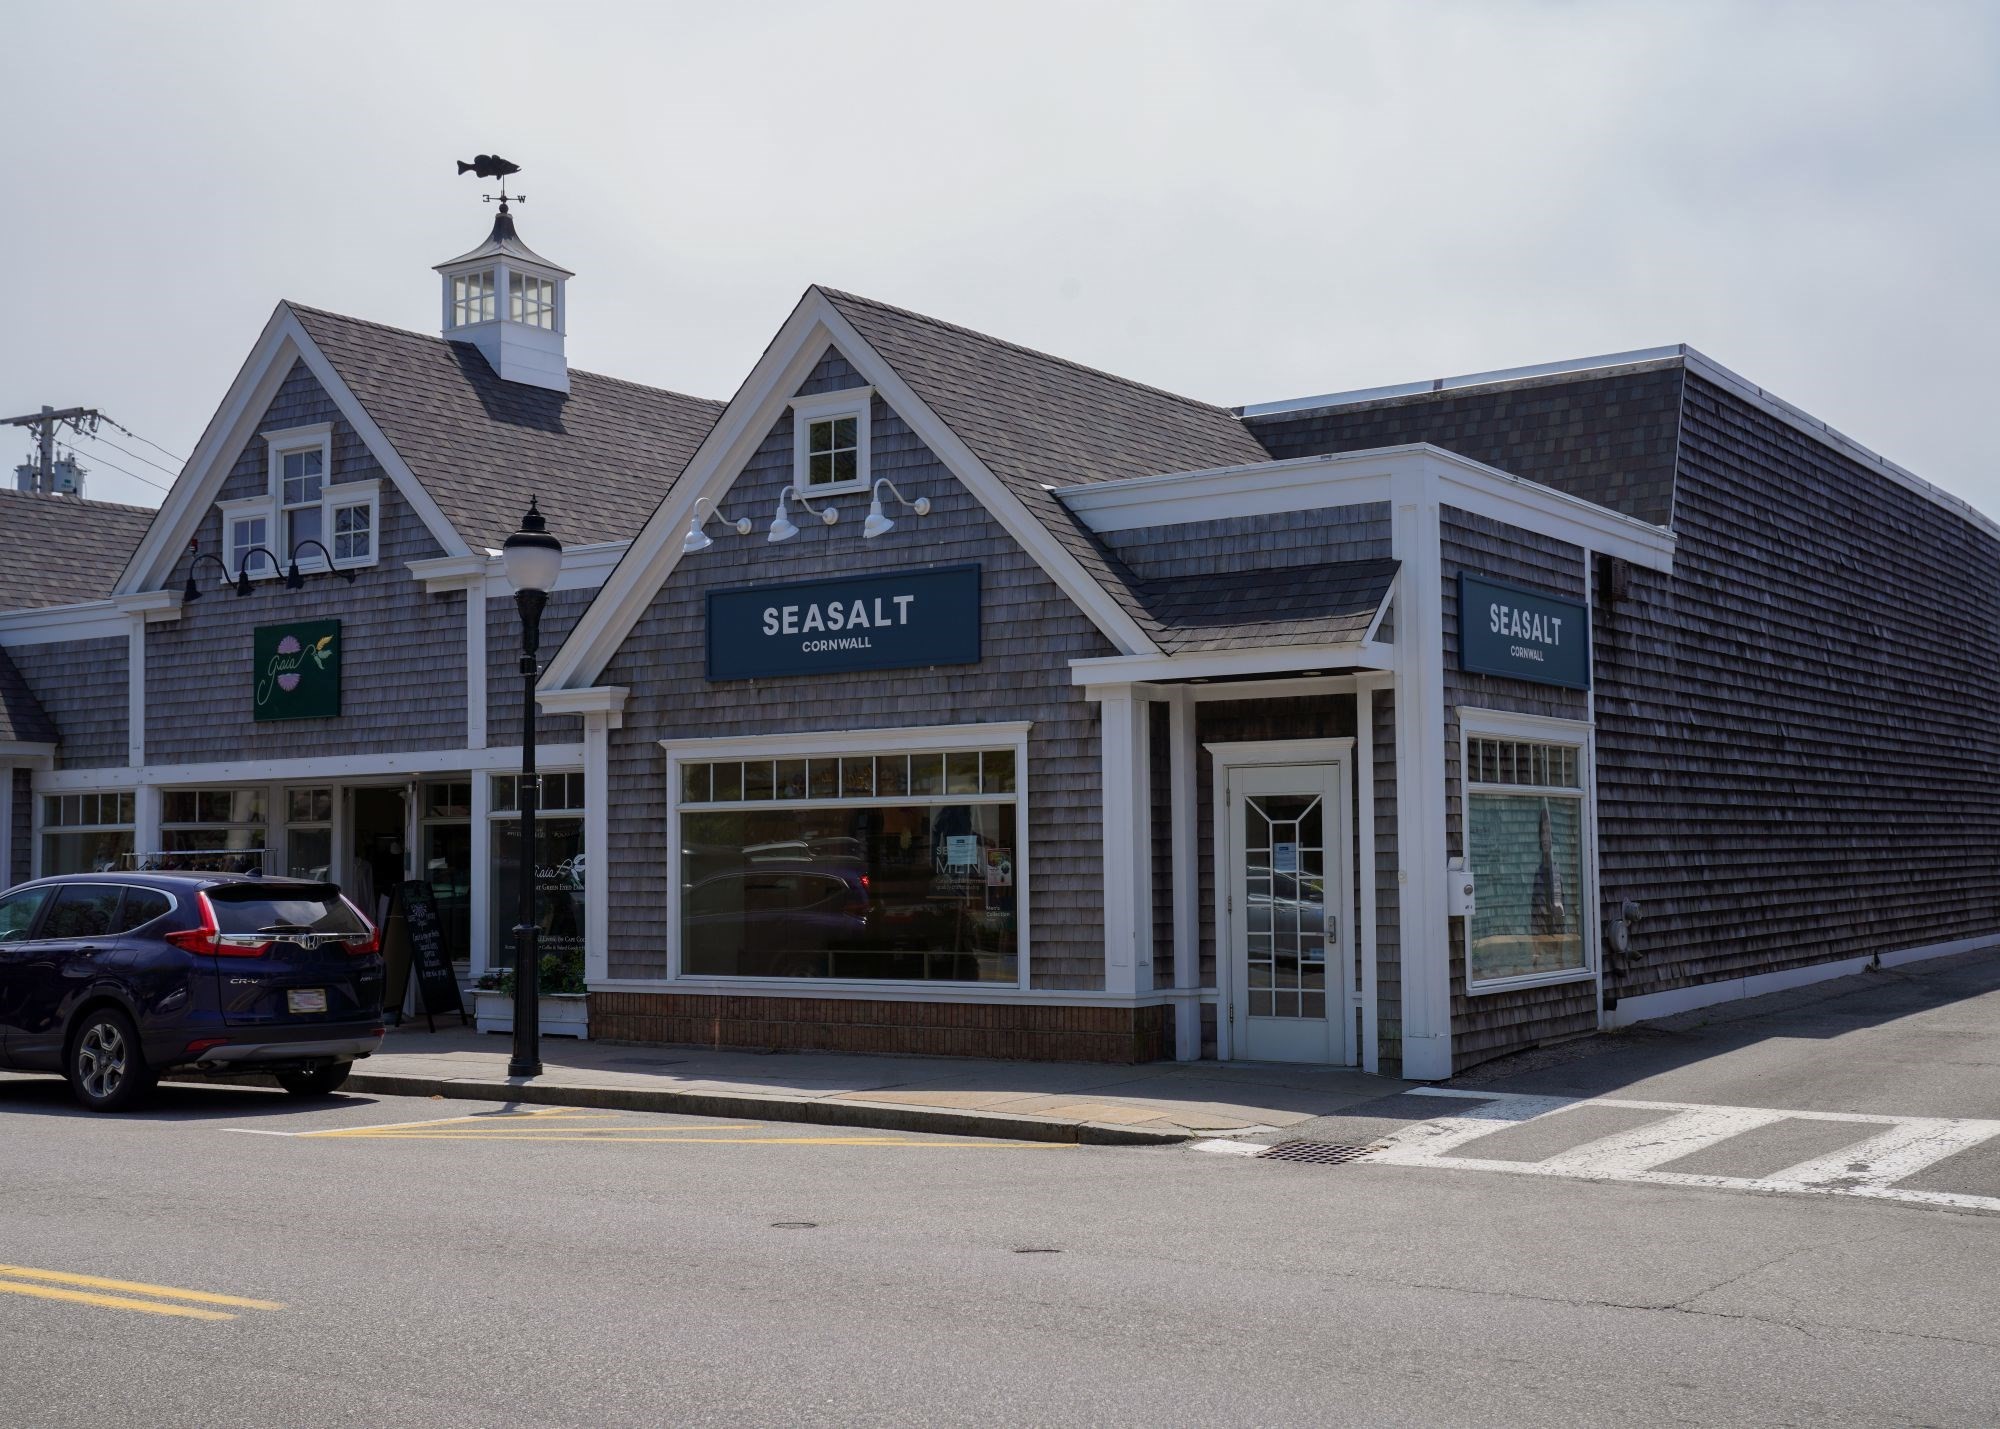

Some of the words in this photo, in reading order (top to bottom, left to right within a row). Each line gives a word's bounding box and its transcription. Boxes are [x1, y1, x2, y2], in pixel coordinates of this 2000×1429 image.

[763, 595, 914, 636] SEASALT
[1490, 603, 1562, 645] SEASALT
[802, 637, 872, 652] CORNWALL
[1510, 645, 1544, 661] CORNWALL
